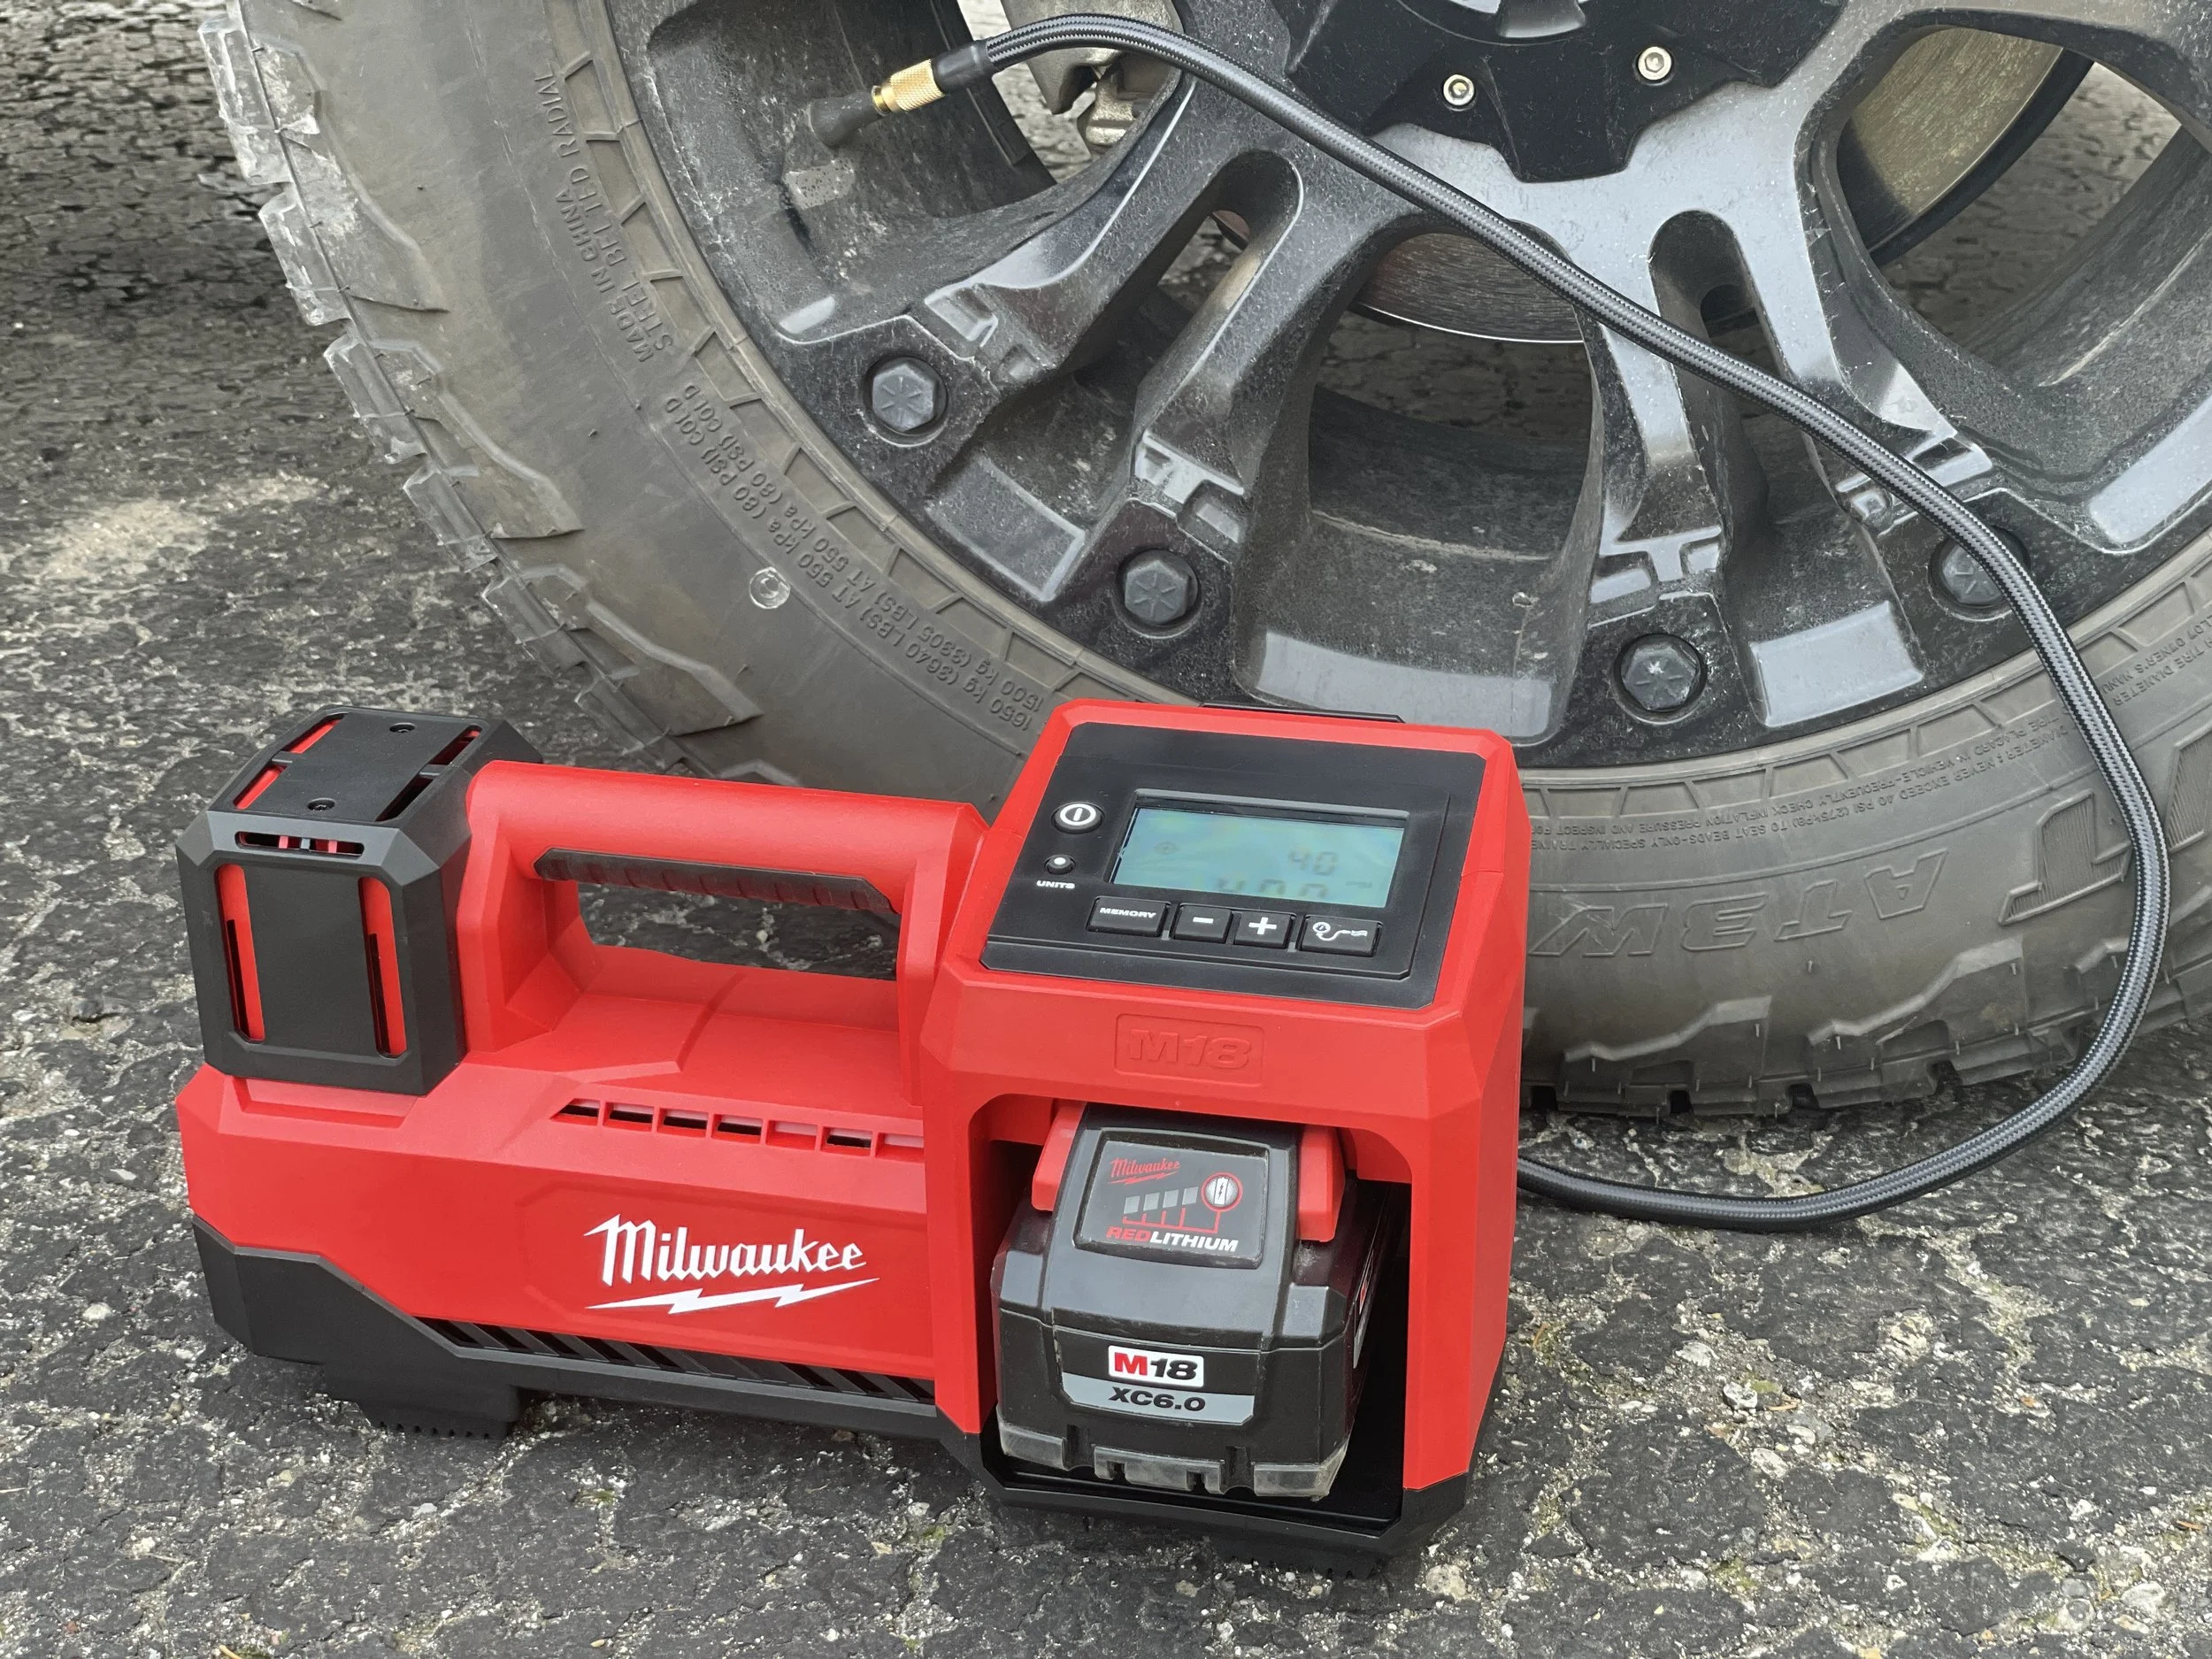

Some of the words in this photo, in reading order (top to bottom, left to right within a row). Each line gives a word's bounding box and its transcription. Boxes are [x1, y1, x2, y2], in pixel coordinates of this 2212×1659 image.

[534, 68, 580, 158] RADIAL
[556, 187, 599, 263] CHINA
[571, 167, 626, 267] BELTED
[591, 268, 616, 294] IN
[620, 272, 672, 351] STEEL
[611, 295, 653, 363] MADE
[664, 397, 704, 446] COLD
[683, 384, 723, 433] COLD
[701, 446, 737, 487] PSI)
[720, 434, 755, 473] PSI)
[733, 485, 765, 519] (80
[752, 472, 784, 505] (80
[768, 518, 801, 555] kPa
[784, 505, 817, 540] kPa
[813, 537, 849, 572] 550
[798, 552, 834, 588] 550
[847, 569, 876, 594] AT
[832, 585, 861, 610] AT
[874, 591, 919, 631] LBS)
[860, 607, 906, 647] LBS)
[905, 642, 959, 686] (3640
[2173, 645, 2204, 670] TIRE
[976, 658, 1000, 687] kg
[2100, 671, 2133, 695] MANU
[2113, 665, 2174, 706] DIAMETER
[963, 677, 988, 704] kg
[1000, 680, 1044, 713] 1500
[990, 698, 1033, 732] 1650
[2004, 726, 2070, 759] DIAMETER
[1901, 777, 1951, 800] EXCEED
[1705, 808, 1768, 826] INFLATION
[1772, 800, 1814, 816] CHECK
[1853, 798, 1874, 813] PSI
[1555, 825, 1605, 834] INSPECT
[1610, 823, 1632, 834] AND
[1638, 818, 1701, 833] PRESSURE
[1733, 825, 1766, 839] SEAT
[1770, 820, 1787, 832] TO
[1529, 839, 1576, 850] TRAINE
[1581, 838, 1646, 850] SPECIALLY
[1289, 847, 1338, 875] 40
[1036, 879, 1076, 889] UNITS
[1099, 907, 1157, 918] MEMORY
[1129, 1028, 1252, 1069] M18
[1110, 1157, 1180, 1178] Milwaukee
[583, 1213, 867, 1287] Milwaukee
[1106, 1225, 1239, 1252] REDLITHIUM
[1114, 1351, 1198, 1380] M18
[1108, 1386, 1206, 1412] XC6.0
